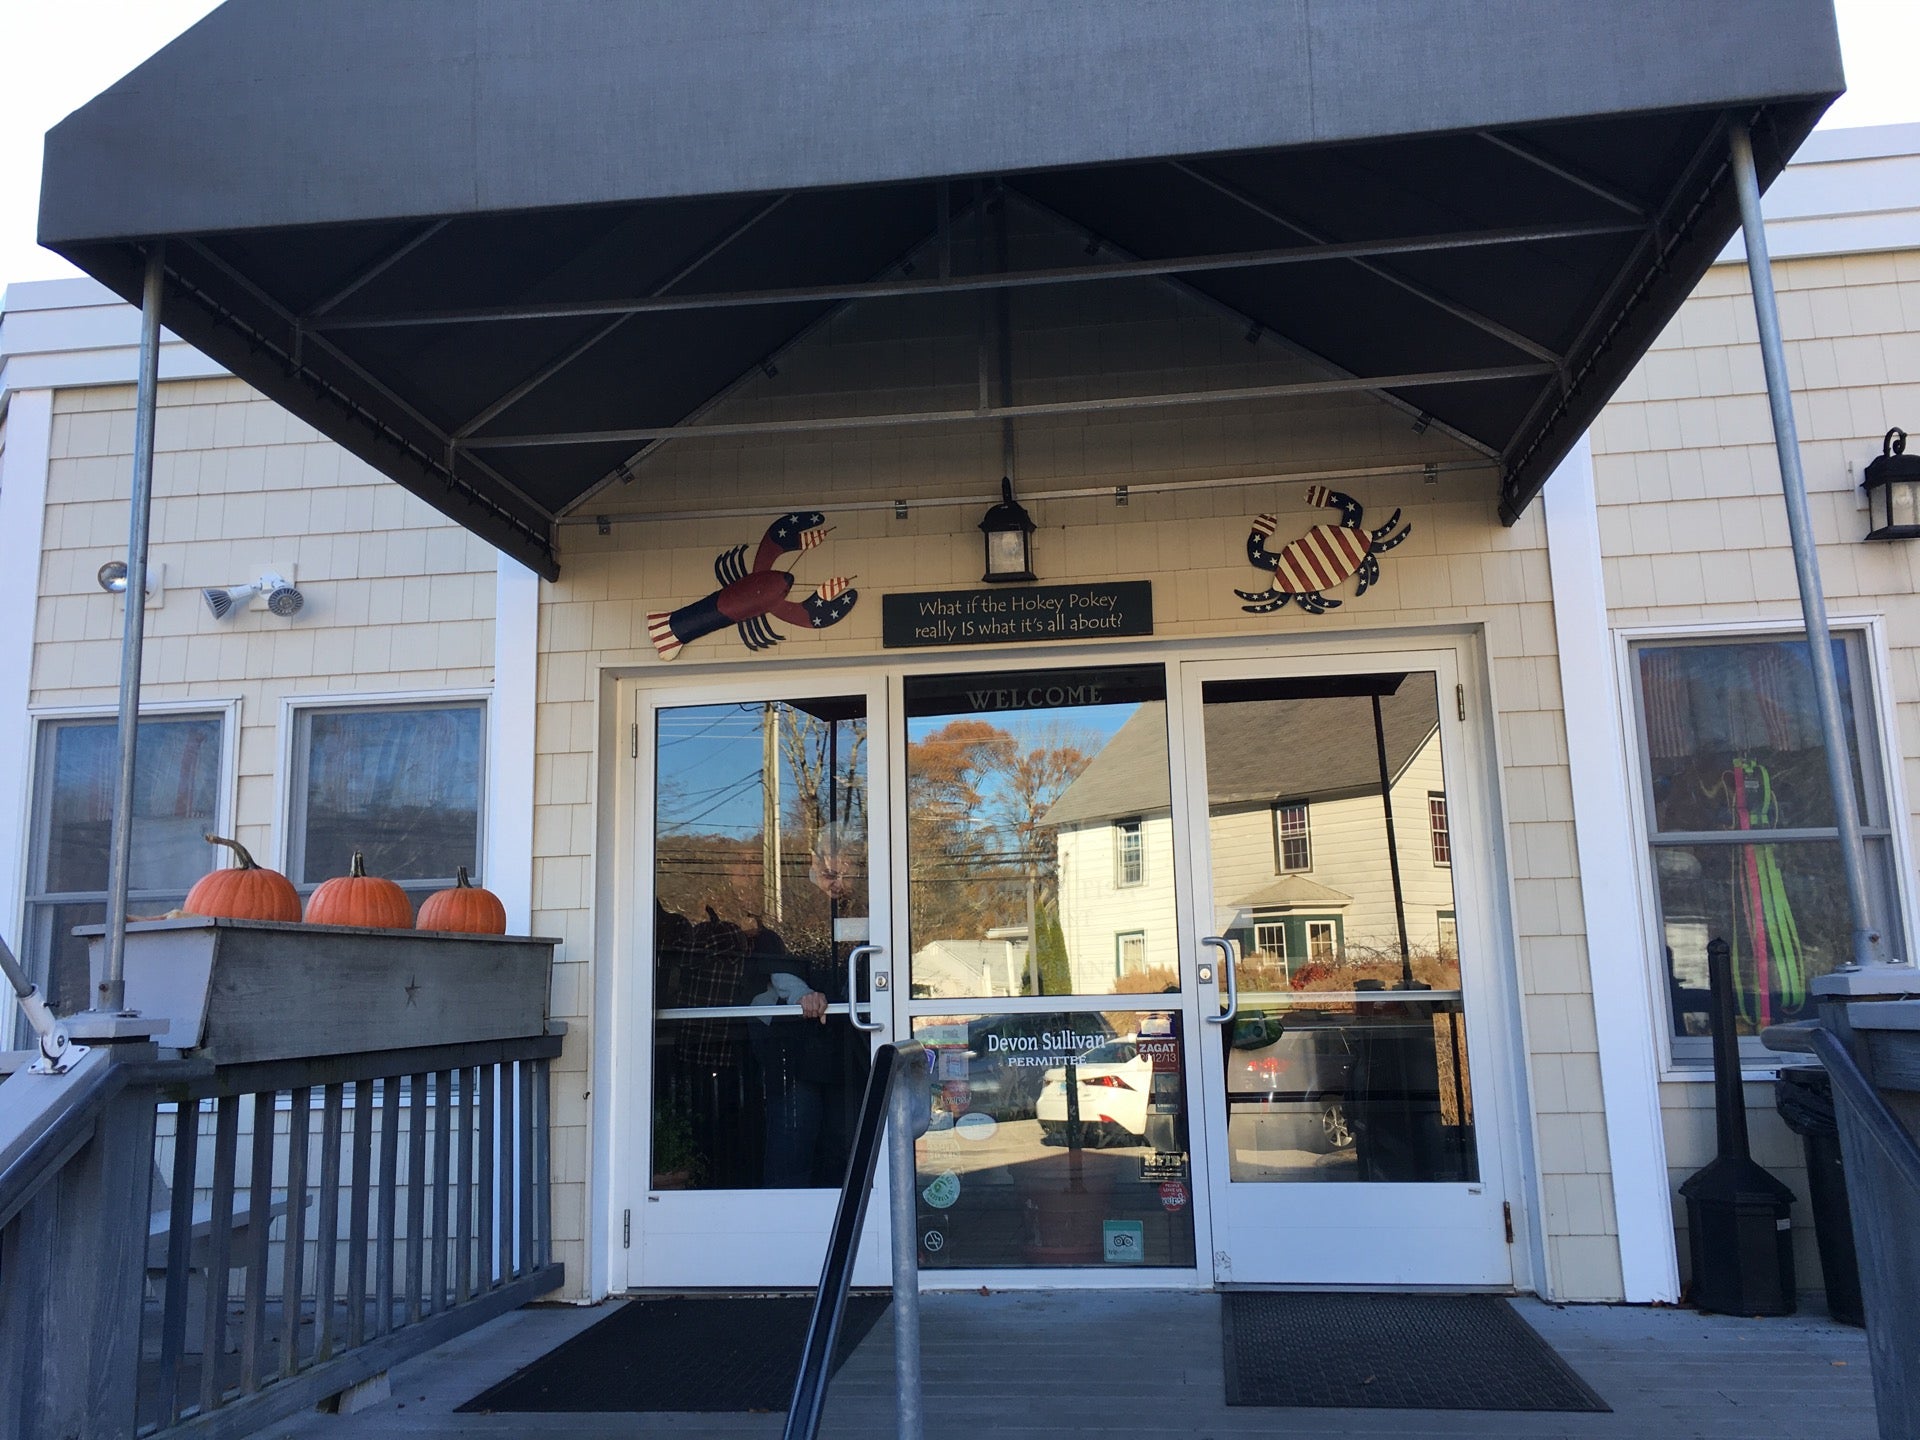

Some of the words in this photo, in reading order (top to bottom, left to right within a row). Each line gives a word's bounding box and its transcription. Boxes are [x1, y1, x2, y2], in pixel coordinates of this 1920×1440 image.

[919, 598, 962, 616] What
[967, 596, 980, 613] if
[981, 595, 1007, 613] the
[1012, 593, 1064, 613] Hokey
[1070, 591, 1118, 611] Pokey
[915, 620, 957, 641] really
[962, 621, 975, 636] IS
[978, 617, 1016, 635] what
[1021, 616, 1043, 633] it's
[1048, 613, 1065, 631] all
[1070, 612, 1123, 630] about?
[966, 685, 1103, 709] WELCOME
[987, 1033, 1039, 1053] Devon
[1042, 1030, 1106, 1051] Sullivan
[1139, 1043, 1176, 1053] ZAGAT
[1008, 1055, 1087, 1067] PERMITTEE
